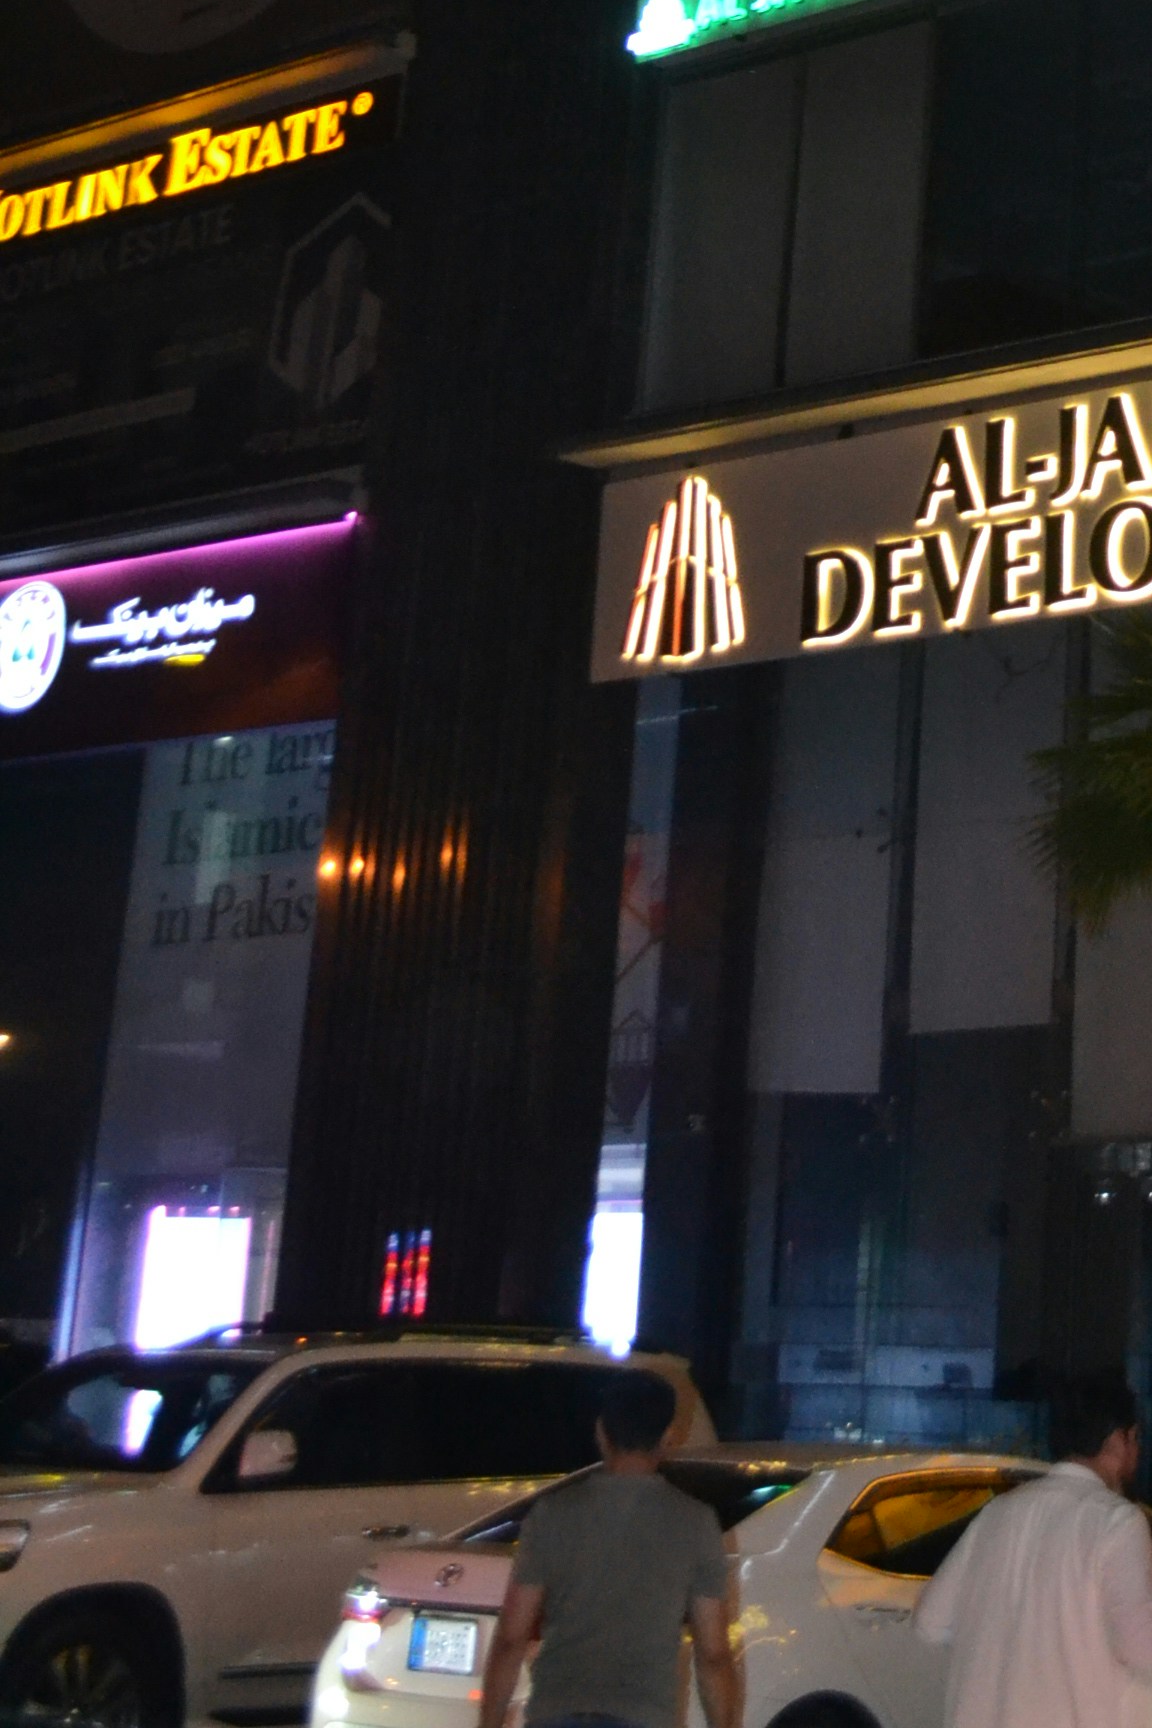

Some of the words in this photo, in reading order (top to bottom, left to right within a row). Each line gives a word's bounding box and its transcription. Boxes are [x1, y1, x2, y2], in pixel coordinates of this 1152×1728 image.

[0, 153, 164, 243] OTLINK
[164, 795, 322, 866] Isamic
[152, 892, 190, 945] in
